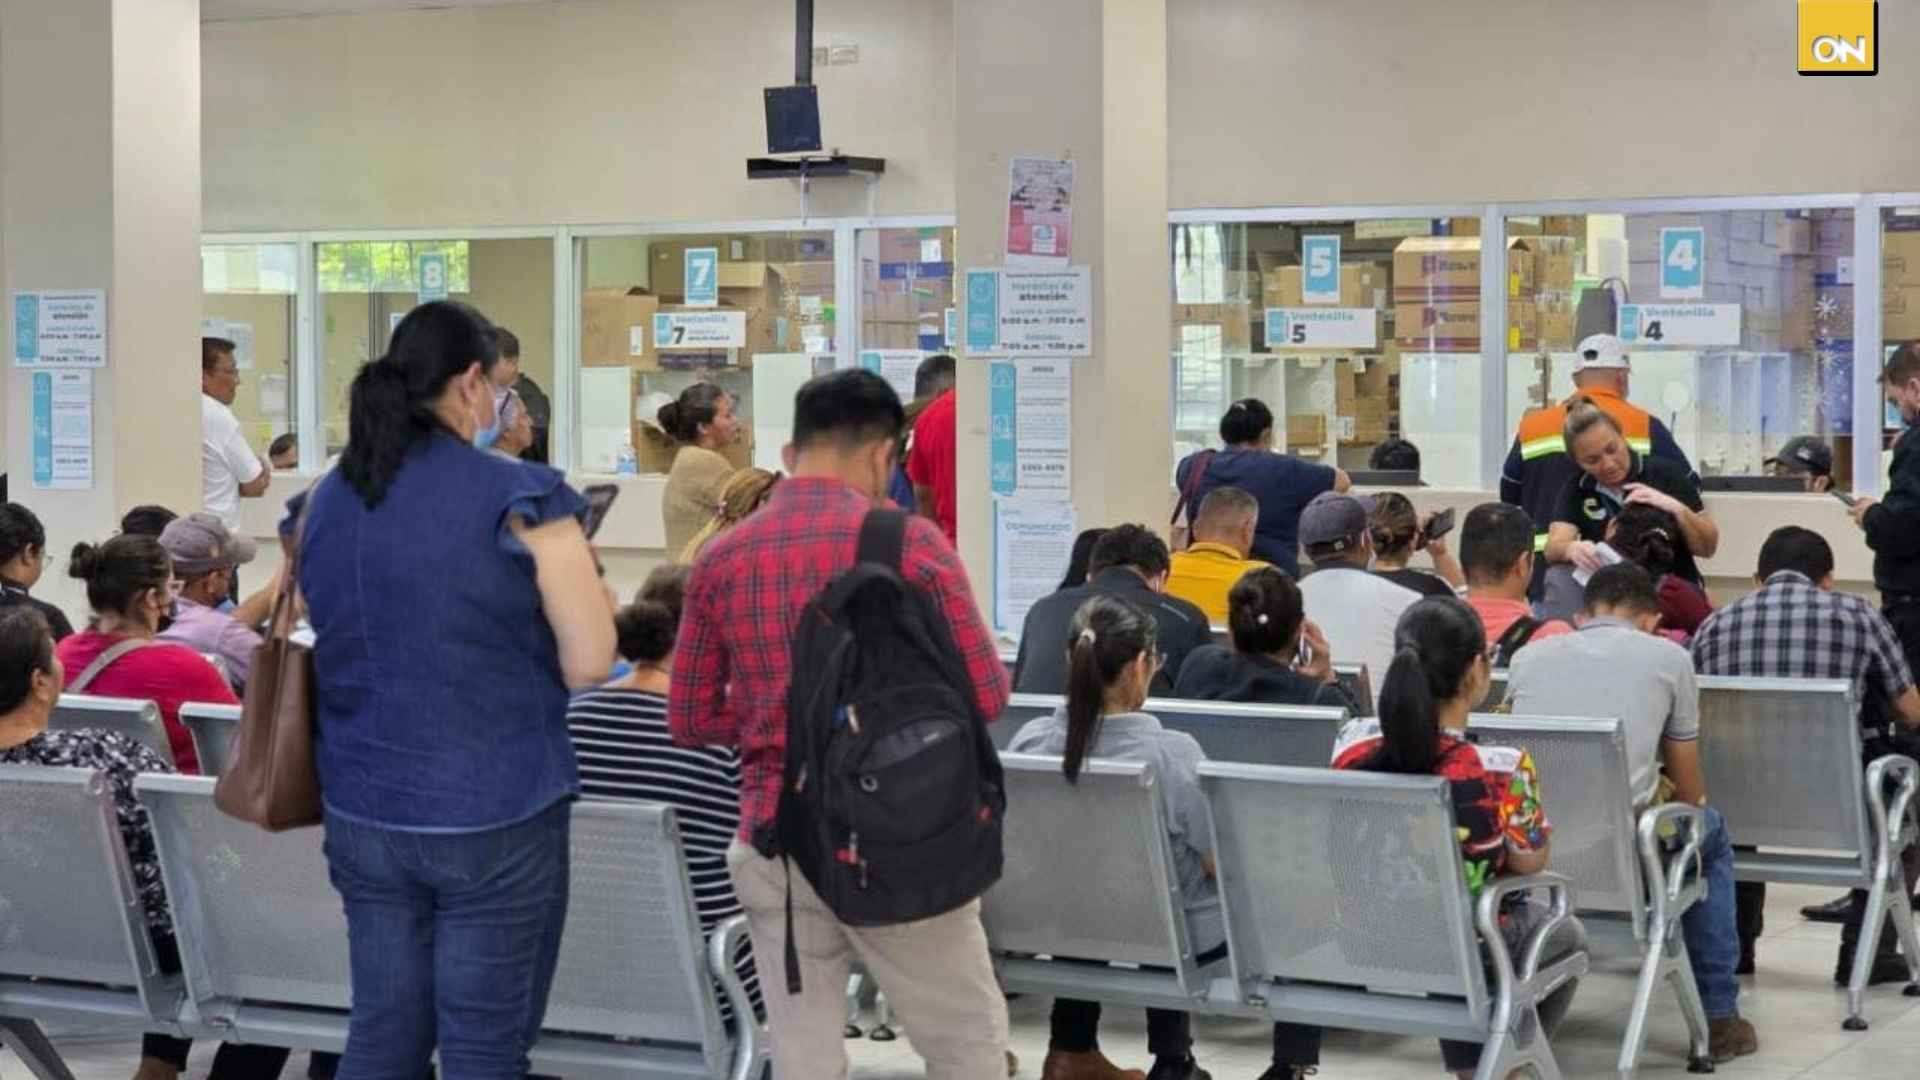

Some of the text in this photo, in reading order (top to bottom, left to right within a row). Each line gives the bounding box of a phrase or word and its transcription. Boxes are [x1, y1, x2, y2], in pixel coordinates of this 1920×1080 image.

[1309, 247, 1332, 277] 5
[1667, 239, 1698, 271] 4
[423, 261, 443, 288] 8
[692, 258, 712, 286] 7
[1019, 291, 1067, 301] atención
[1290, 311, 1354, 321] Ventanilla
[1644, 306, 1716, 317] Ventanilla
[672, 325, 686, 345] 7
[1291, 324, 1307, 344] 5
[1644, 320, 1664, 341] 4
